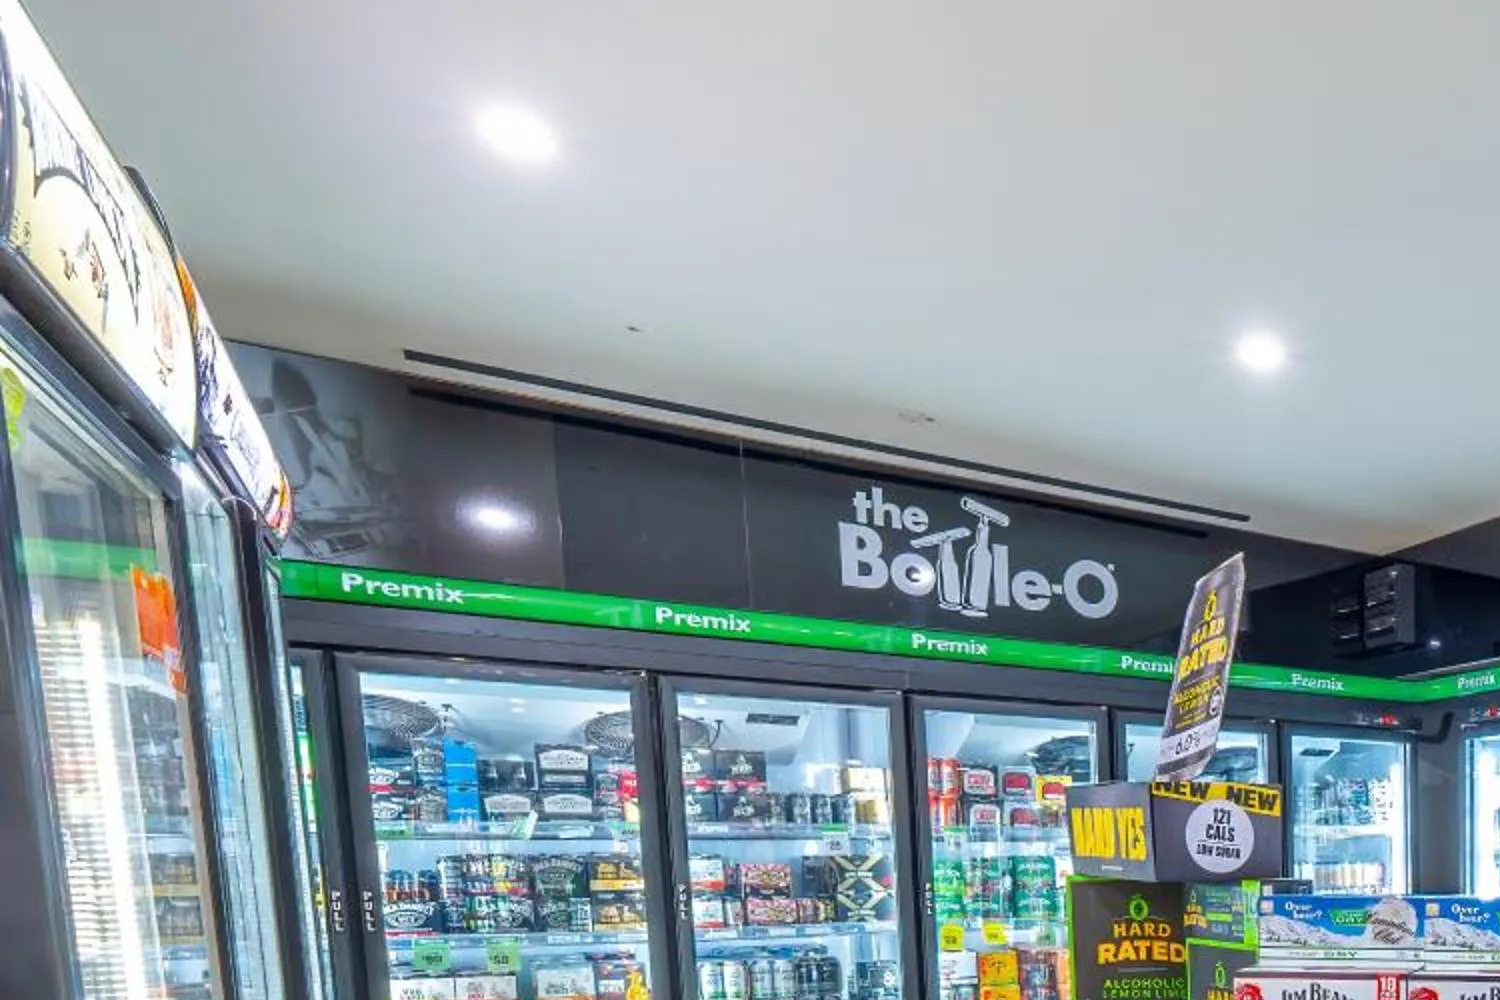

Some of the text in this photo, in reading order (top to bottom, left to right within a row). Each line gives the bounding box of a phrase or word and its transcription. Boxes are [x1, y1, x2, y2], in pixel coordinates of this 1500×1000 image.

[852, 486, 929, 533] the
[838, 496, 1119, 618] Bottle-O
[340, 572, 464, 604] Premix
[654, 606, 752, 634] Premix
[912, 633, 990, 657] Premix
[1120, 654, 1175, 673] Premi
[1291, 673, 1345, 691] Premix
[1457, 673, 1496, 689] Premix
[1153, 780, 1279, 811] NEW NEW
[1213, 808, 1231, 824] 121
[1116, 807, 1148, 861] YES
[1205, 824, 1236, 843] CALS
[331, 890, 345, 931] PULL
[363, 891, 376, 931] PULL
[1285, 901, 1312, 913] Over
[1451, 903, 1480, 915] Over
[1112, 922, 1171, 938] HARD
[1097, 939, 1187, 966] RATED
[1103, 977, 1185, 989] ALCOHOLIC
[1378, 977, 1396, 992] 10
[1103, 989, 1151, 1000] LEMON
